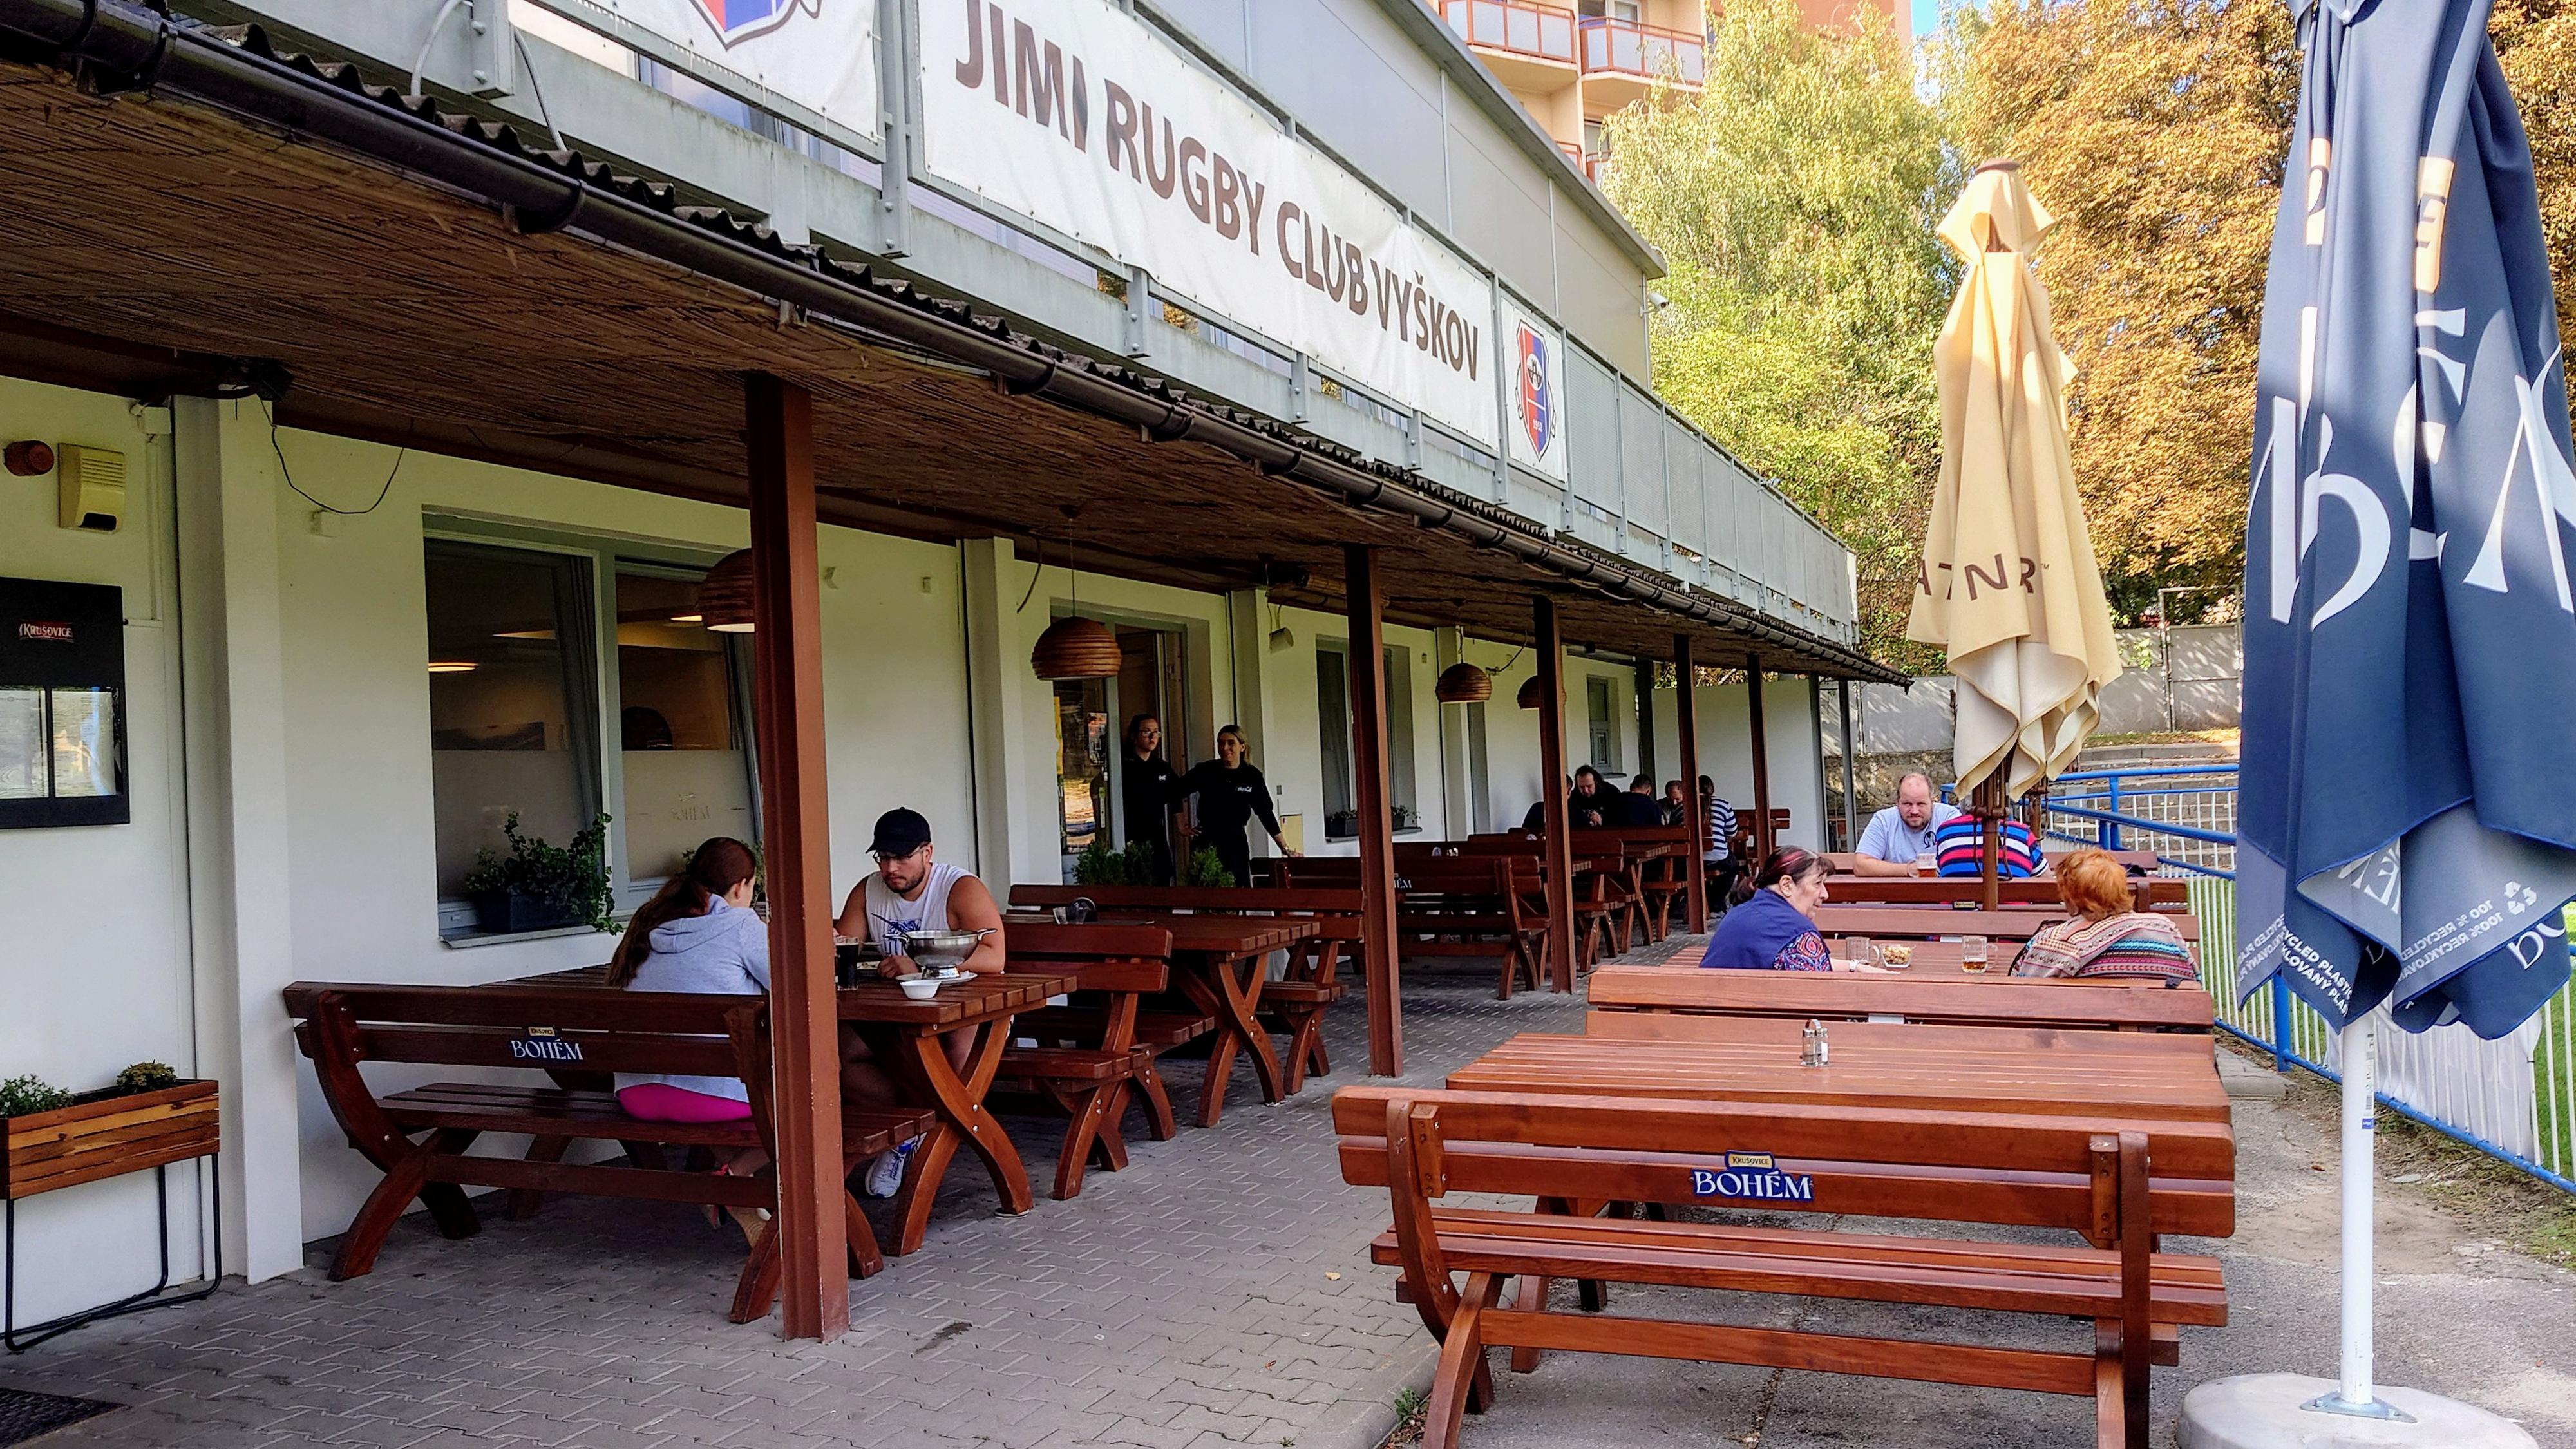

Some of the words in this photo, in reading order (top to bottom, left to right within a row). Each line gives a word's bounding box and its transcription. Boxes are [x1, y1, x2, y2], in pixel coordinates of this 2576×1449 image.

[956, 0, 1088, 153] JIMI
[1104, 78, 1265, 256] RUGBY
[1277, 202, 1368, 317] CLUB
[1370, 258, 1479, 381] VYŠKOV
[23, 623, 72, 638] KRUŠOVICE
[2283, 926, 2320, 963] YCLED
[2281, 942, 2332, 990] KLOVANÝ
[2328, 988, 2349, 1018] PLAS
[511, 1037, 583, 1061] BOHÉM
[1694, 1171, 1813, 1199] BOHÉM
